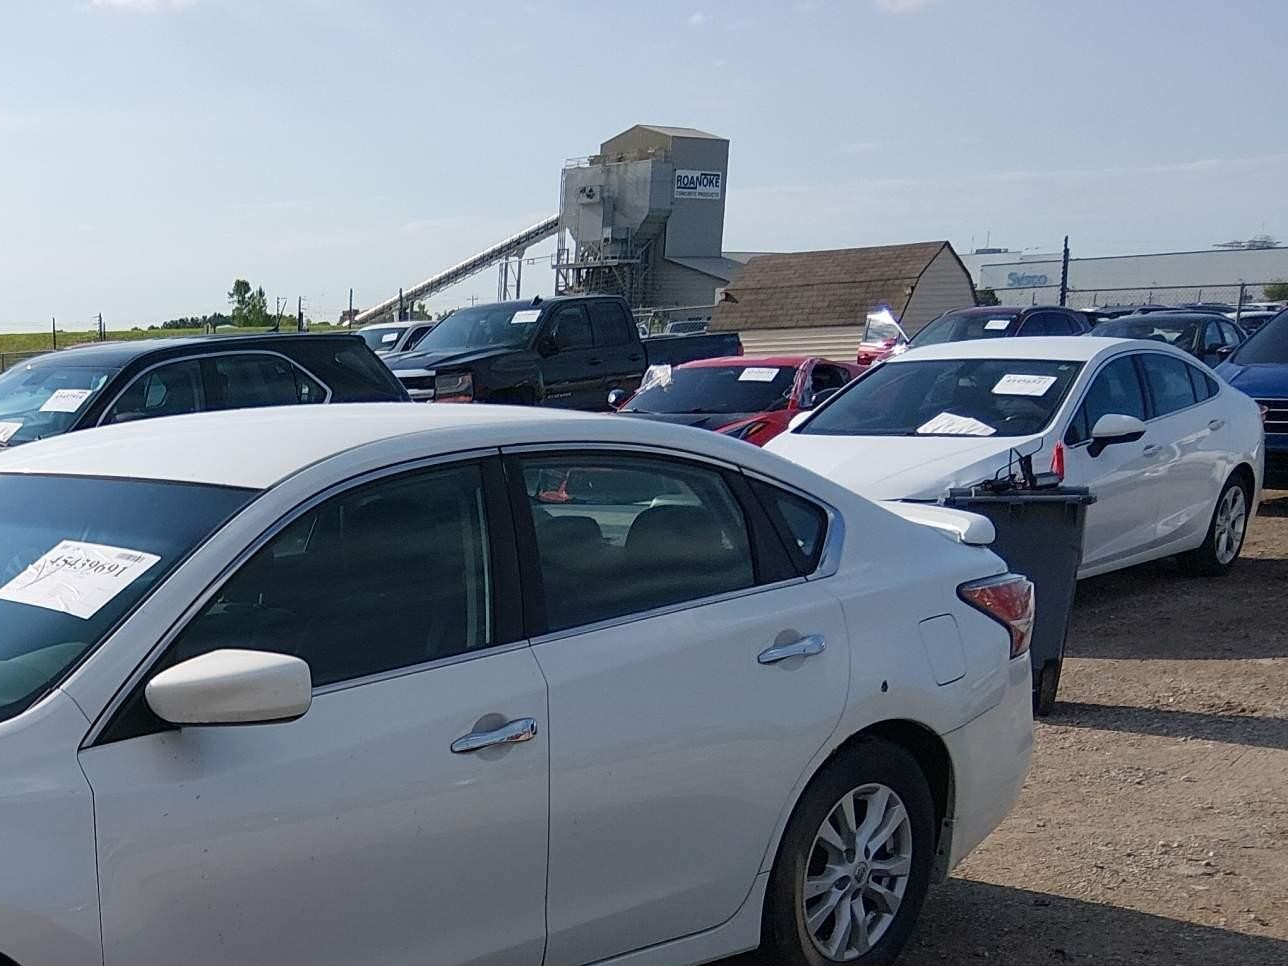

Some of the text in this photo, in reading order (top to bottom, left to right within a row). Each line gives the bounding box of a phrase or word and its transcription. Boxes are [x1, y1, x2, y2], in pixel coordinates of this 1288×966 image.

[676, 174, 720, 189] ROANOKE
[1007, 271, 1048, 287] Sysco
[49, 554, 128, 578] 45439691
